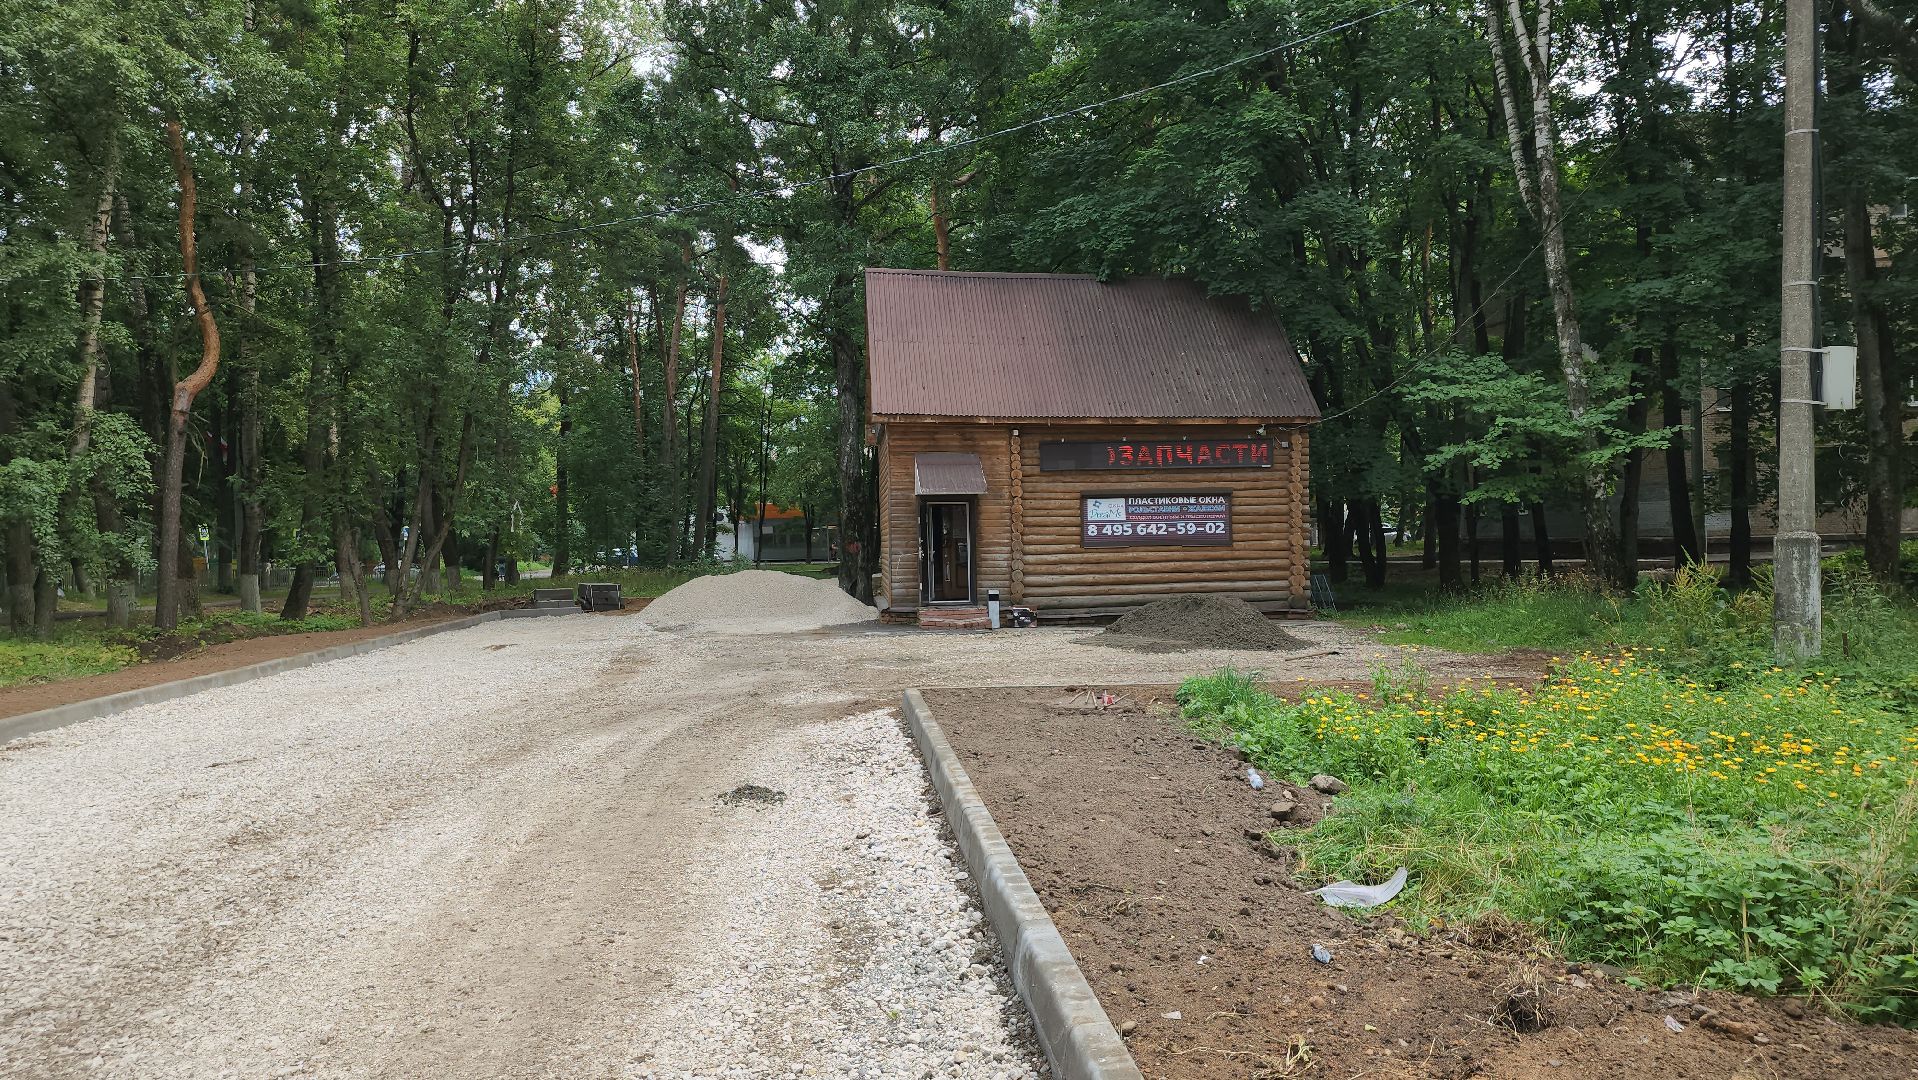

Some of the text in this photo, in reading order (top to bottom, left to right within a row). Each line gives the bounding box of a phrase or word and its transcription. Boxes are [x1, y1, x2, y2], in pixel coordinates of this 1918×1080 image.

[1128, 496, 1226, 505] ПЛАСТИКОВЫЕ ОКНА
[1087, 522, 1226, 536] 8 495 642-59-02
